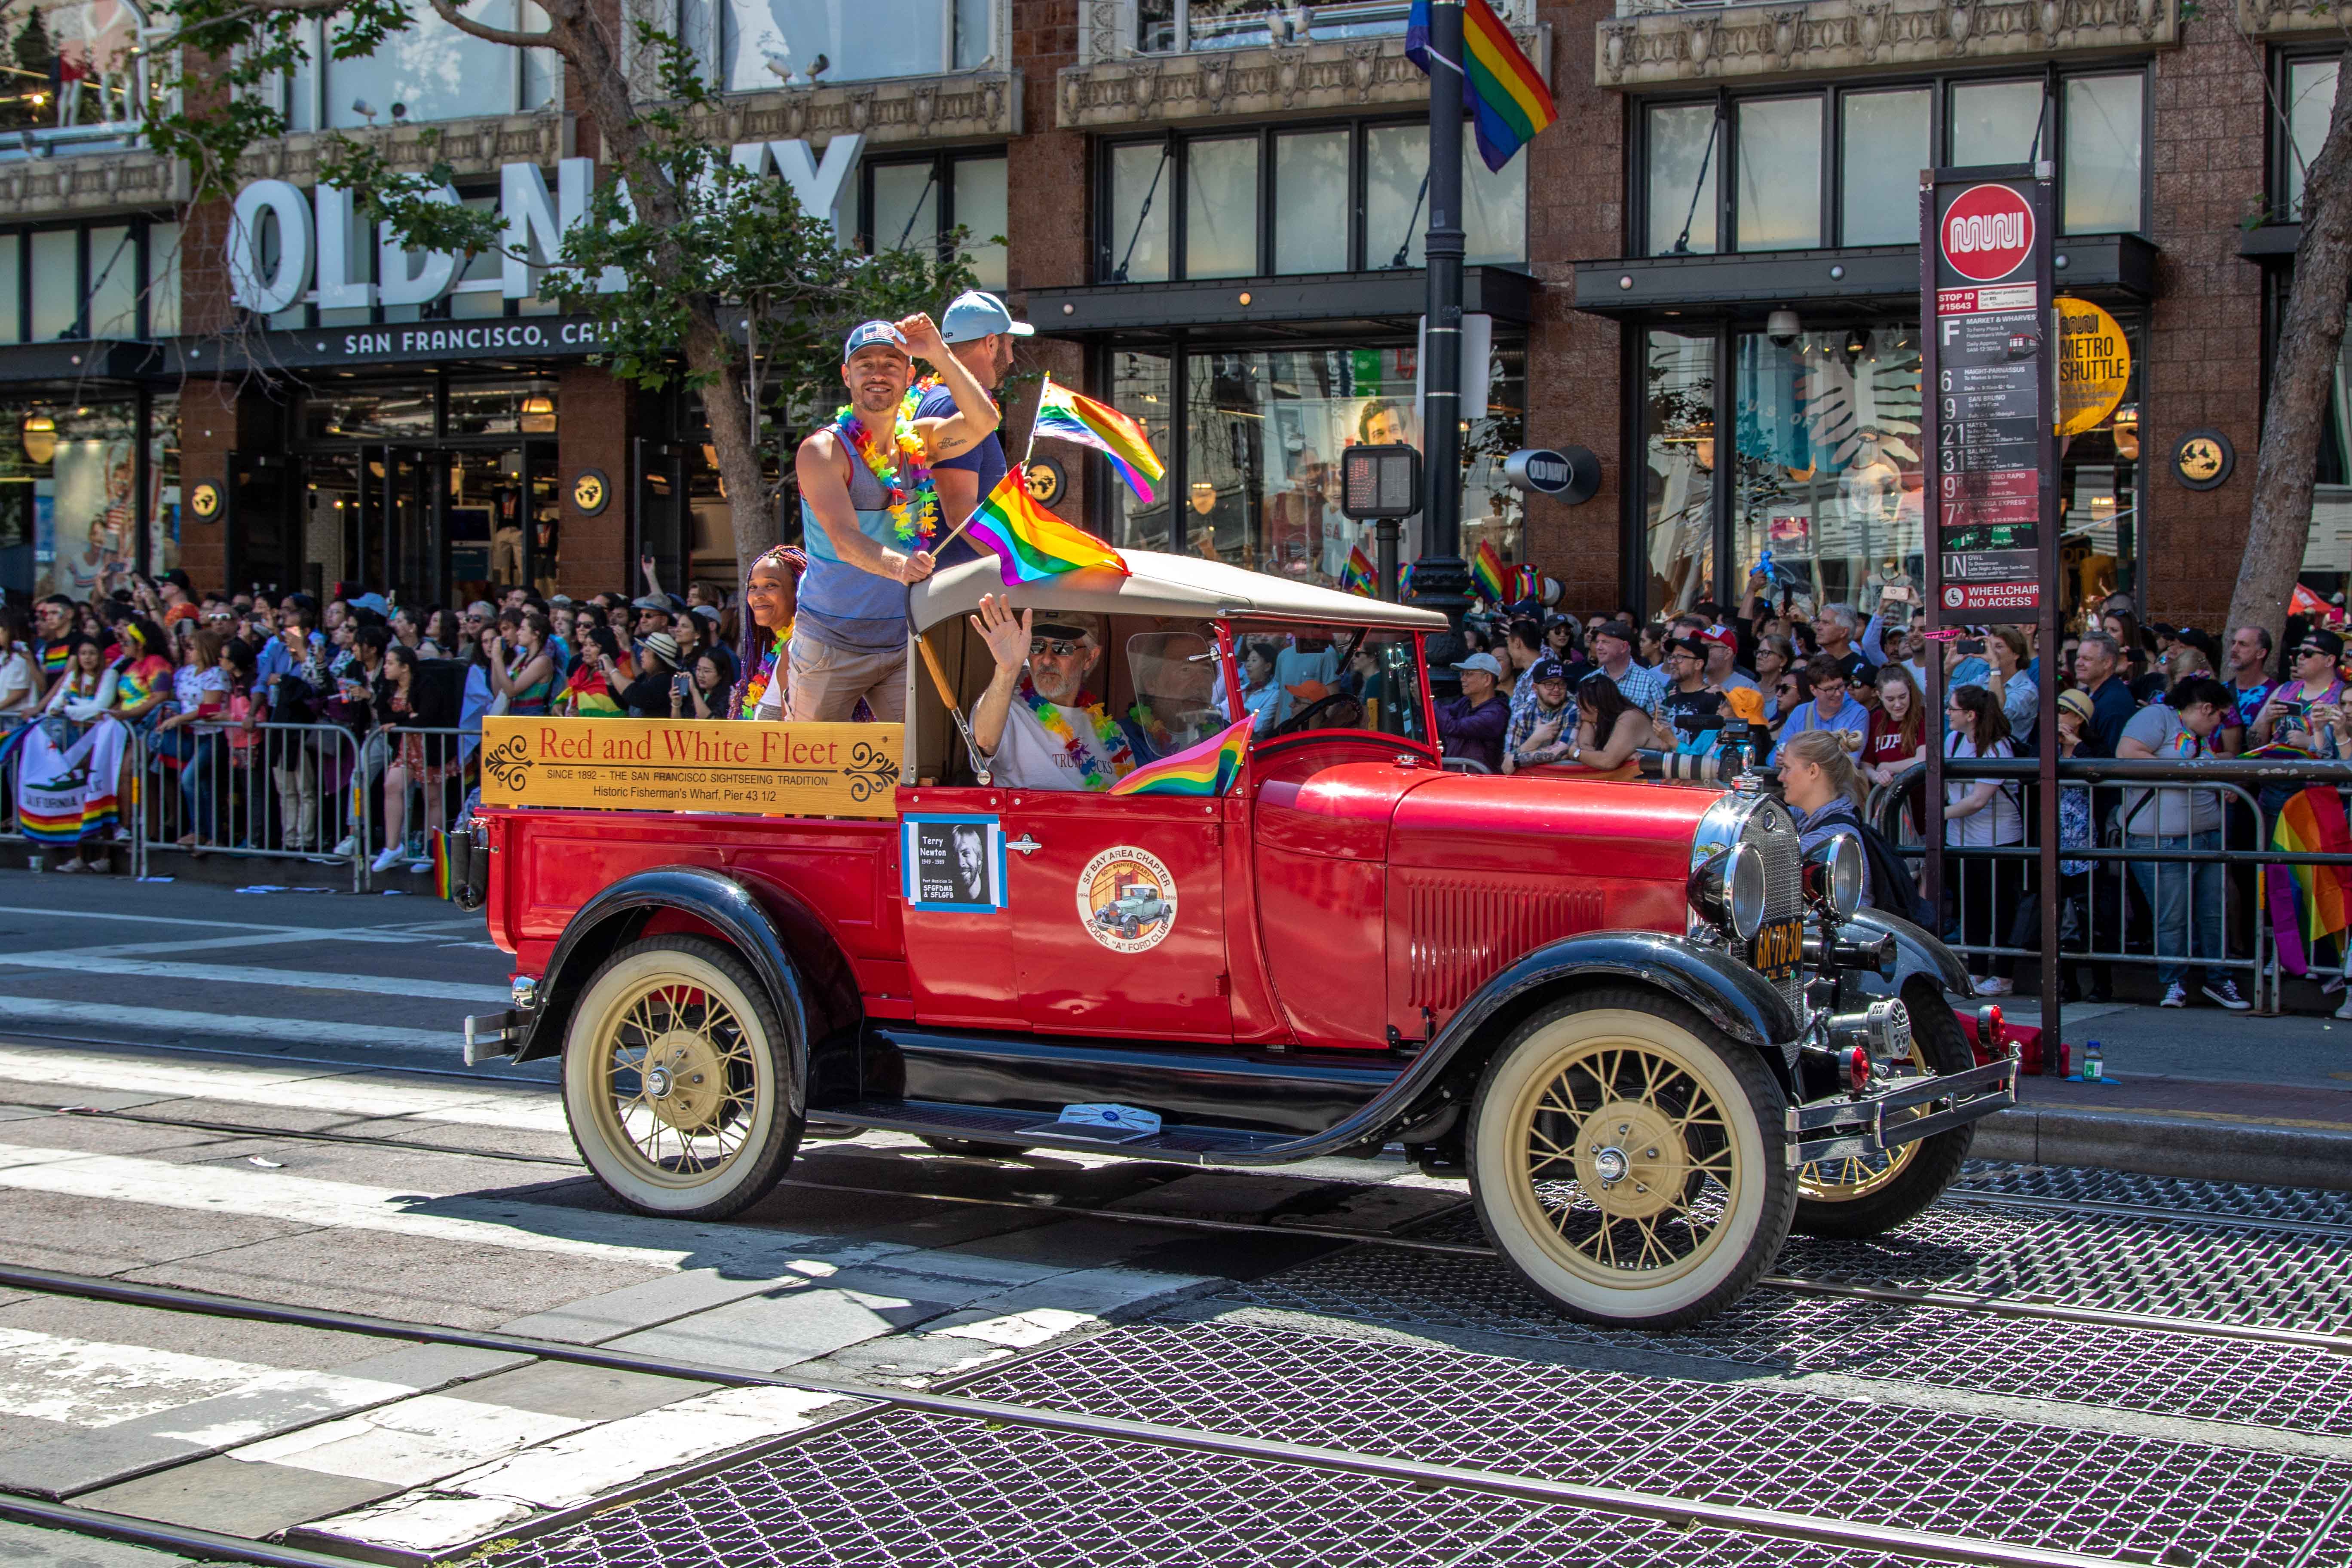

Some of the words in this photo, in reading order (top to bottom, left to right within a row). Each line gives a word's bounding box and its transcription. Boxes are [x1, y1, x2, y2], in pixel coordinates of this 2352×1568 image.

[227, 173, 463, 315] OLD
[1939, 294, 1963, 302] STOP
[1939, 302, 1972, 310] #15643
[2001, 314, 2037, 322] WHARVES
[345, 333, 391, 354] SAN
[403, 325, 548, 351] FRANCISCO,
[1944, 320, 1960, 346] F
[2061, 336, 2114, 359] METRO
[1941, 370, 1952, 392] 6
[2061, 358, 2125, 382] SHUTTLE
[1944, 398, 1956, 420] 9
[1943, 423, 1964, 445] 21
[1529, 459, 1546, 479] OLD
[1943, 450, 1964, 472] 31
[1942, 555, 1967, 577] LN
[1968, 585, 2040, 596] WHEELCHAIR
[1968, 598, 1985, 607] NO
[1988, 597, 2032, 606] ACCESS
[539, 727, 593, 759] Red
[603, 729, 652, 760] and
[662, 730, 750, 763] White
[760, 732, 839, 765] Fleet
[547, 769, 573, 779] SINCE
[578, 770, 597, 780] 1892
[609, 771, 627, 781] THE
[631, 771, 649, 781] SAN
[653, 772, 706, 782] FRANCISCO
[710, 773, 773, 784] SIGHTSEEING
[777, 775, 828, 786] TRADITION
[594, 785, 628, 797] Historic
[631, 786, 687, 799] Fisherman's
[689, 788, 721, 801] Wharf,
[723, 790, 744, 800] Pier
[746, 790, 758, 801] 43
[762, 791, 776, 802] 1/2
[920, 848, 946, 857] Newton
[922, 836, 943, 847] Terry
[1082, 871, 1093, 885] SF
[1090, 855, 1107, 872] BAY
[1109, 849, 1133, 860] AREA
[1136, 852, 1171, 887] CHAPTER
[1113, 862, 1152, 877] ANNIVERSARY
[1085, 918, 1109, 946] MODEL
[1128, 939, 1152, 951] FORD
[1151, 922, 1170, 943] CLUB
[1767, 970, 1779, 980] CAL
